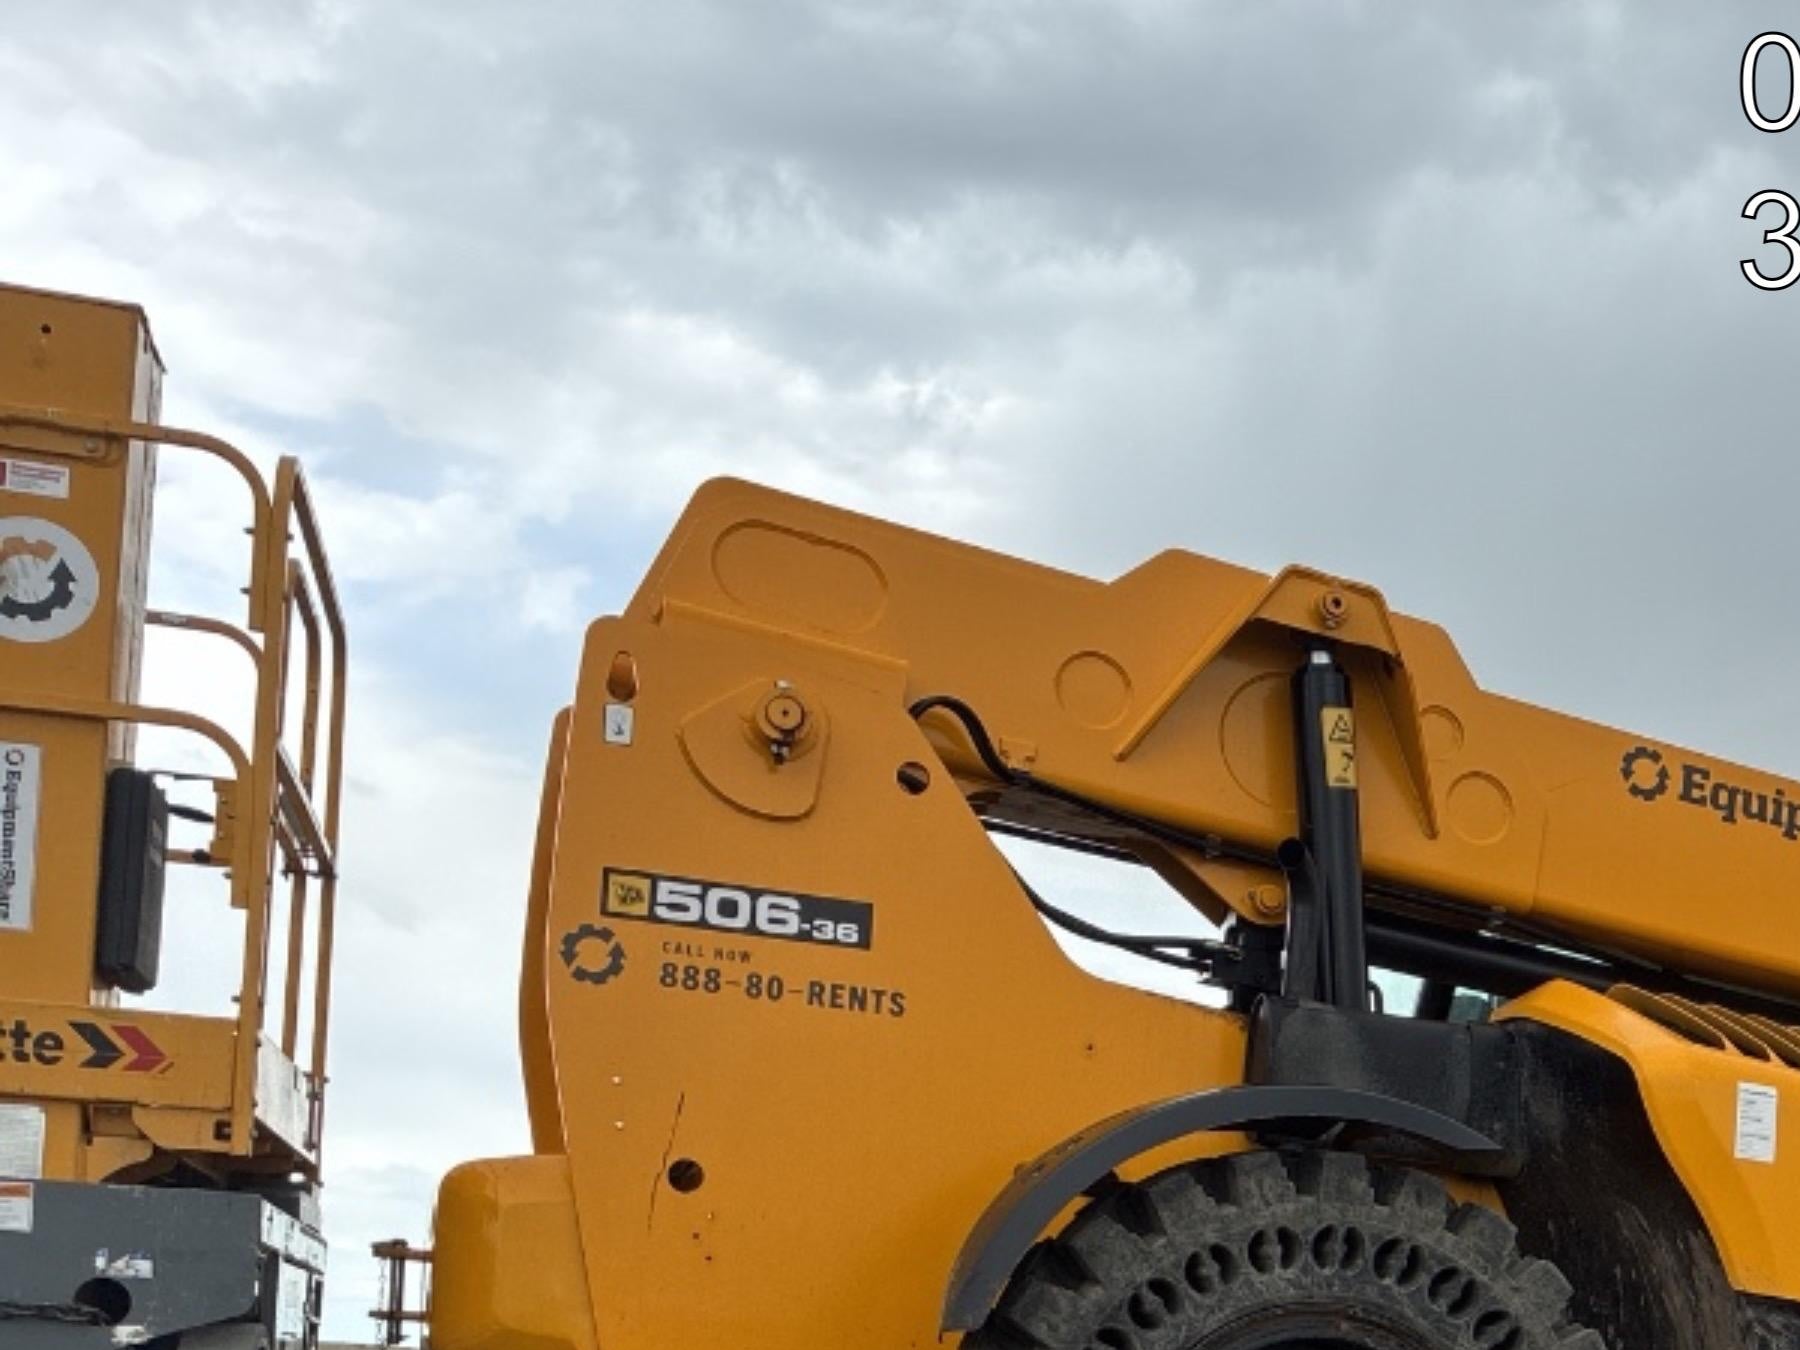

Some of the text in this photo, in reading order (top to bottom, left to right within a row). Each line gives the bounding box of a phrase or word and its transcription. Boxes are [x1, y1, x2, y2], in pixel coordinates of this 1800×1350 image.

[653, 879, 860, 944] 506-36
[662, 941, 752, 964] CALL NOW
[659, 961, 907, 1018] 888-80-RENTS
